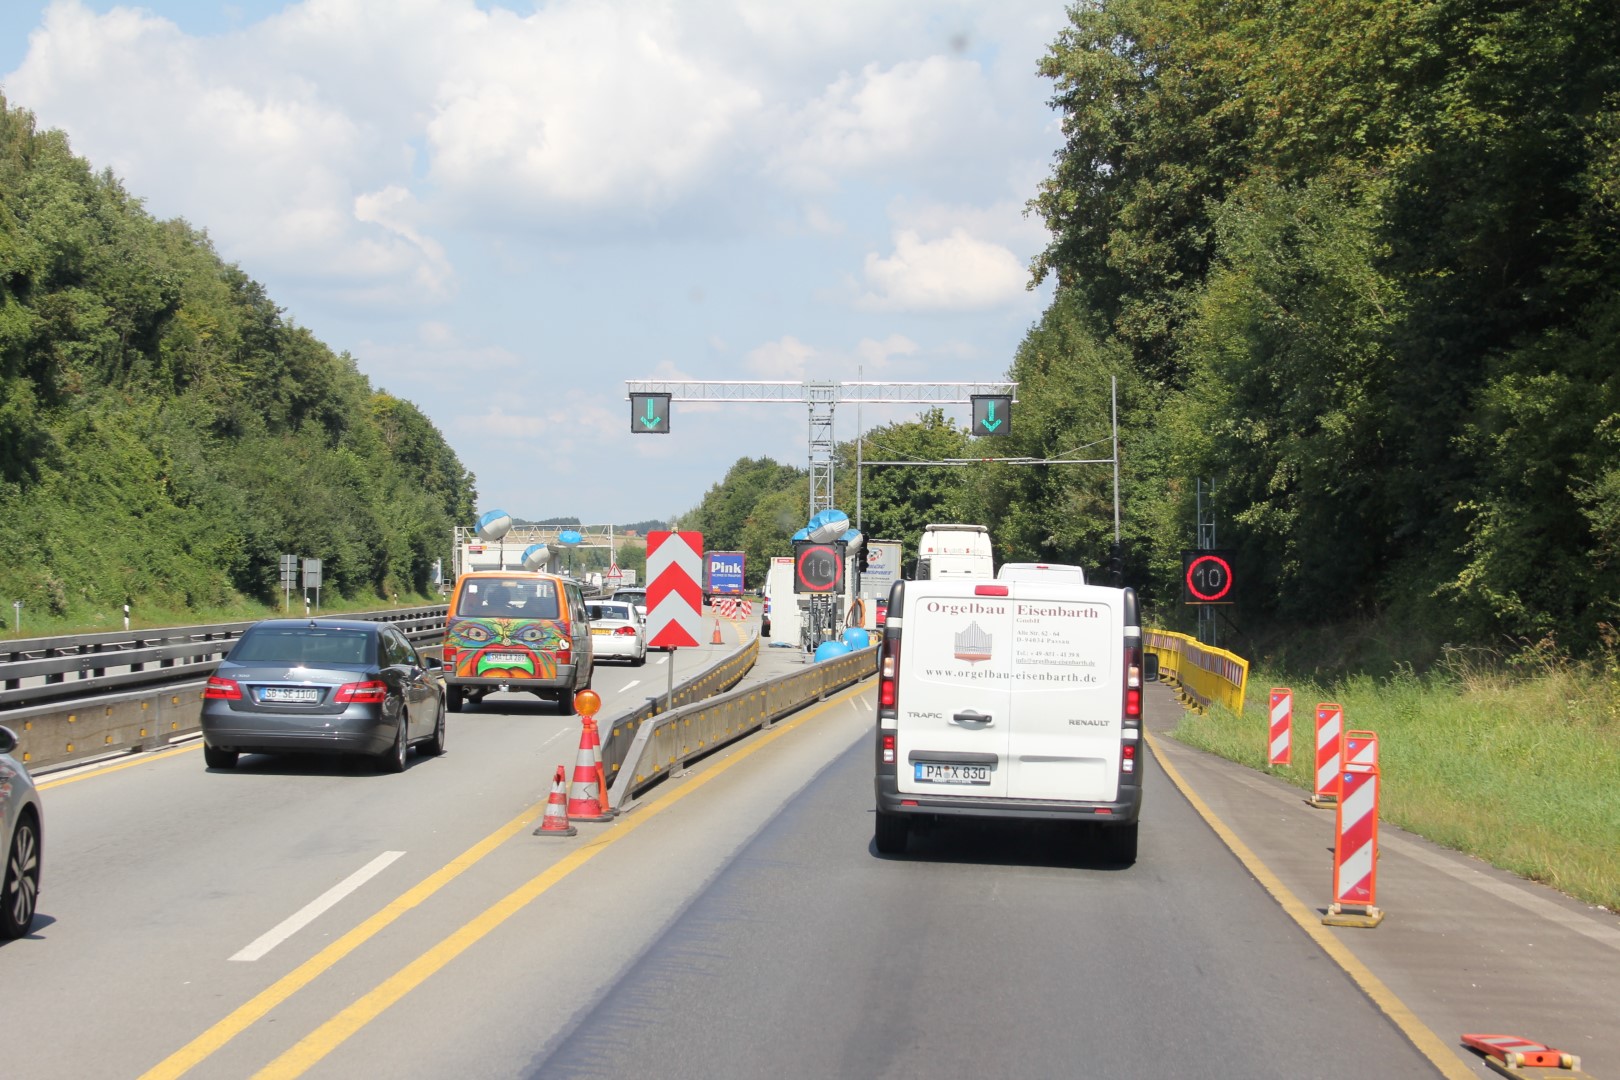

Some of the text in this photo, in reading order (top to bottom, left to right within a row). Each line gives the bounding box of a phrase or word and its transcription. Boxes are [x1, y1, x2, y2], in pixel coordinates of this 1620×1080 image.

[711, 561, 742, 573] Pink
[808, 559, 832, 577] 10
[1196, 568, 1221, 588] 10
[927, 601, 1099, 618] Orgelbau Eisenbarth
[925, 669, 1097, 683] www.orgelbau-eisenbarth.de
[266, 688, 317, 699] SB SE 1100
[907, 711, 943, 719] TRAFIC
[1068, 719, 1111, 727] RENAULT
[926, 765, 986, 780] PA X 830
